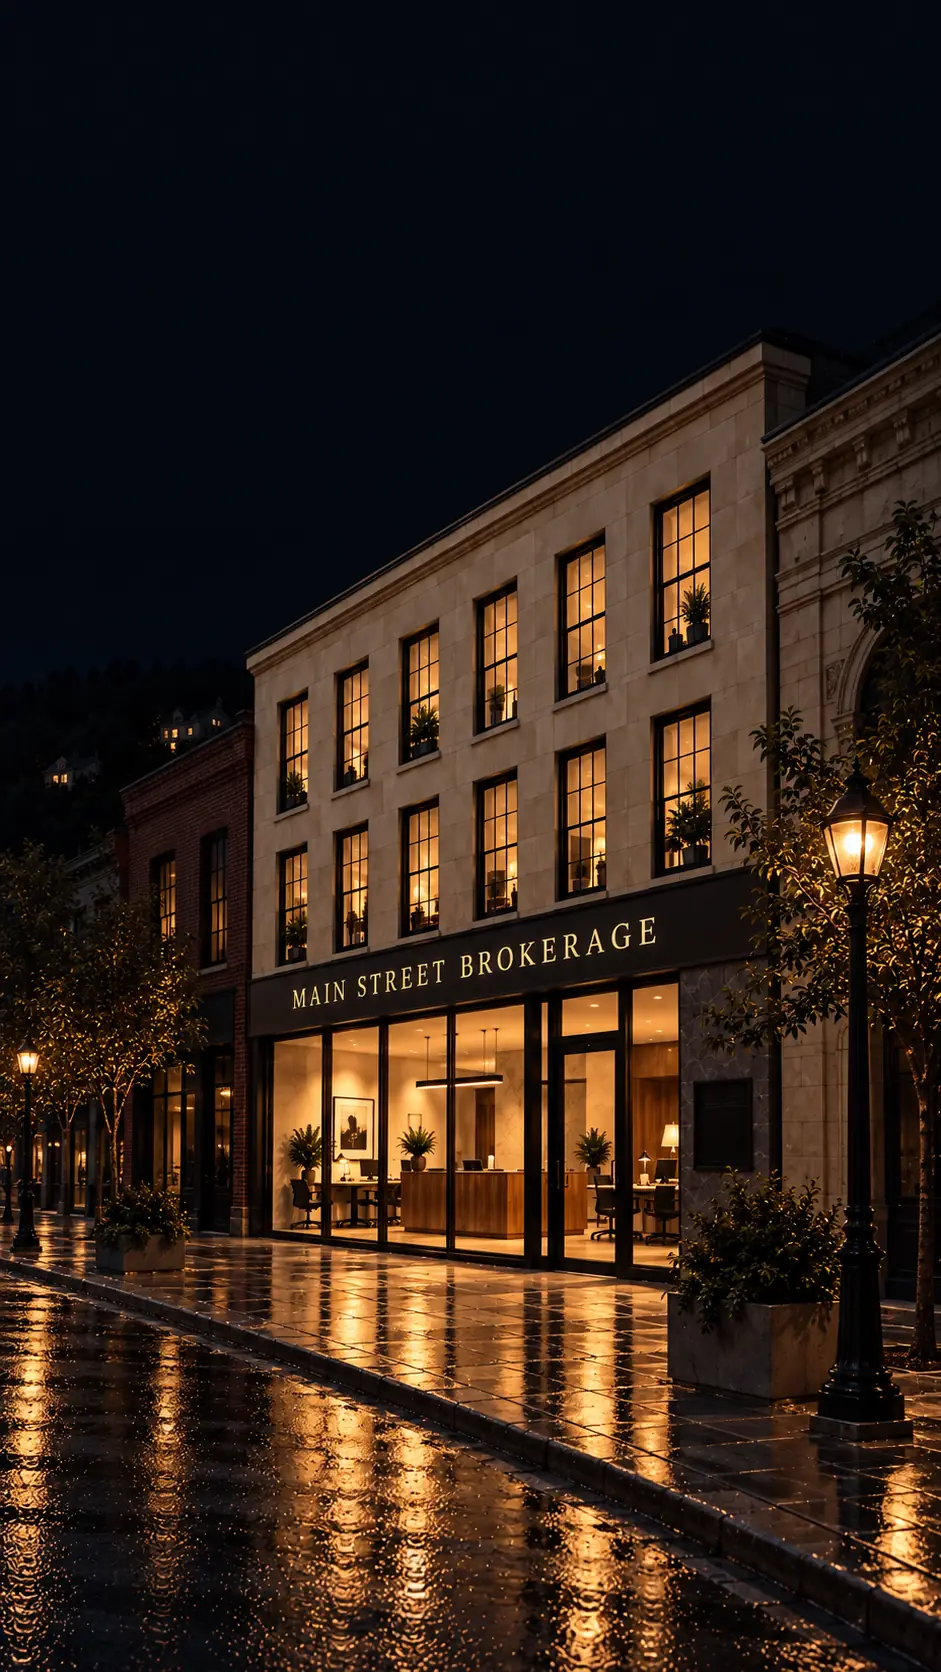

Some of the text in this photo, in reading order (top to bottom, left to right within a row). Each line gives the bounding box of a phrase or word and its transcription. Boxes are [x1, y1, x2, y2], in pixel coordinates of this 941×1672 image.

[292, 916, 657, 1010] MAIN STREET BROKERAGE
